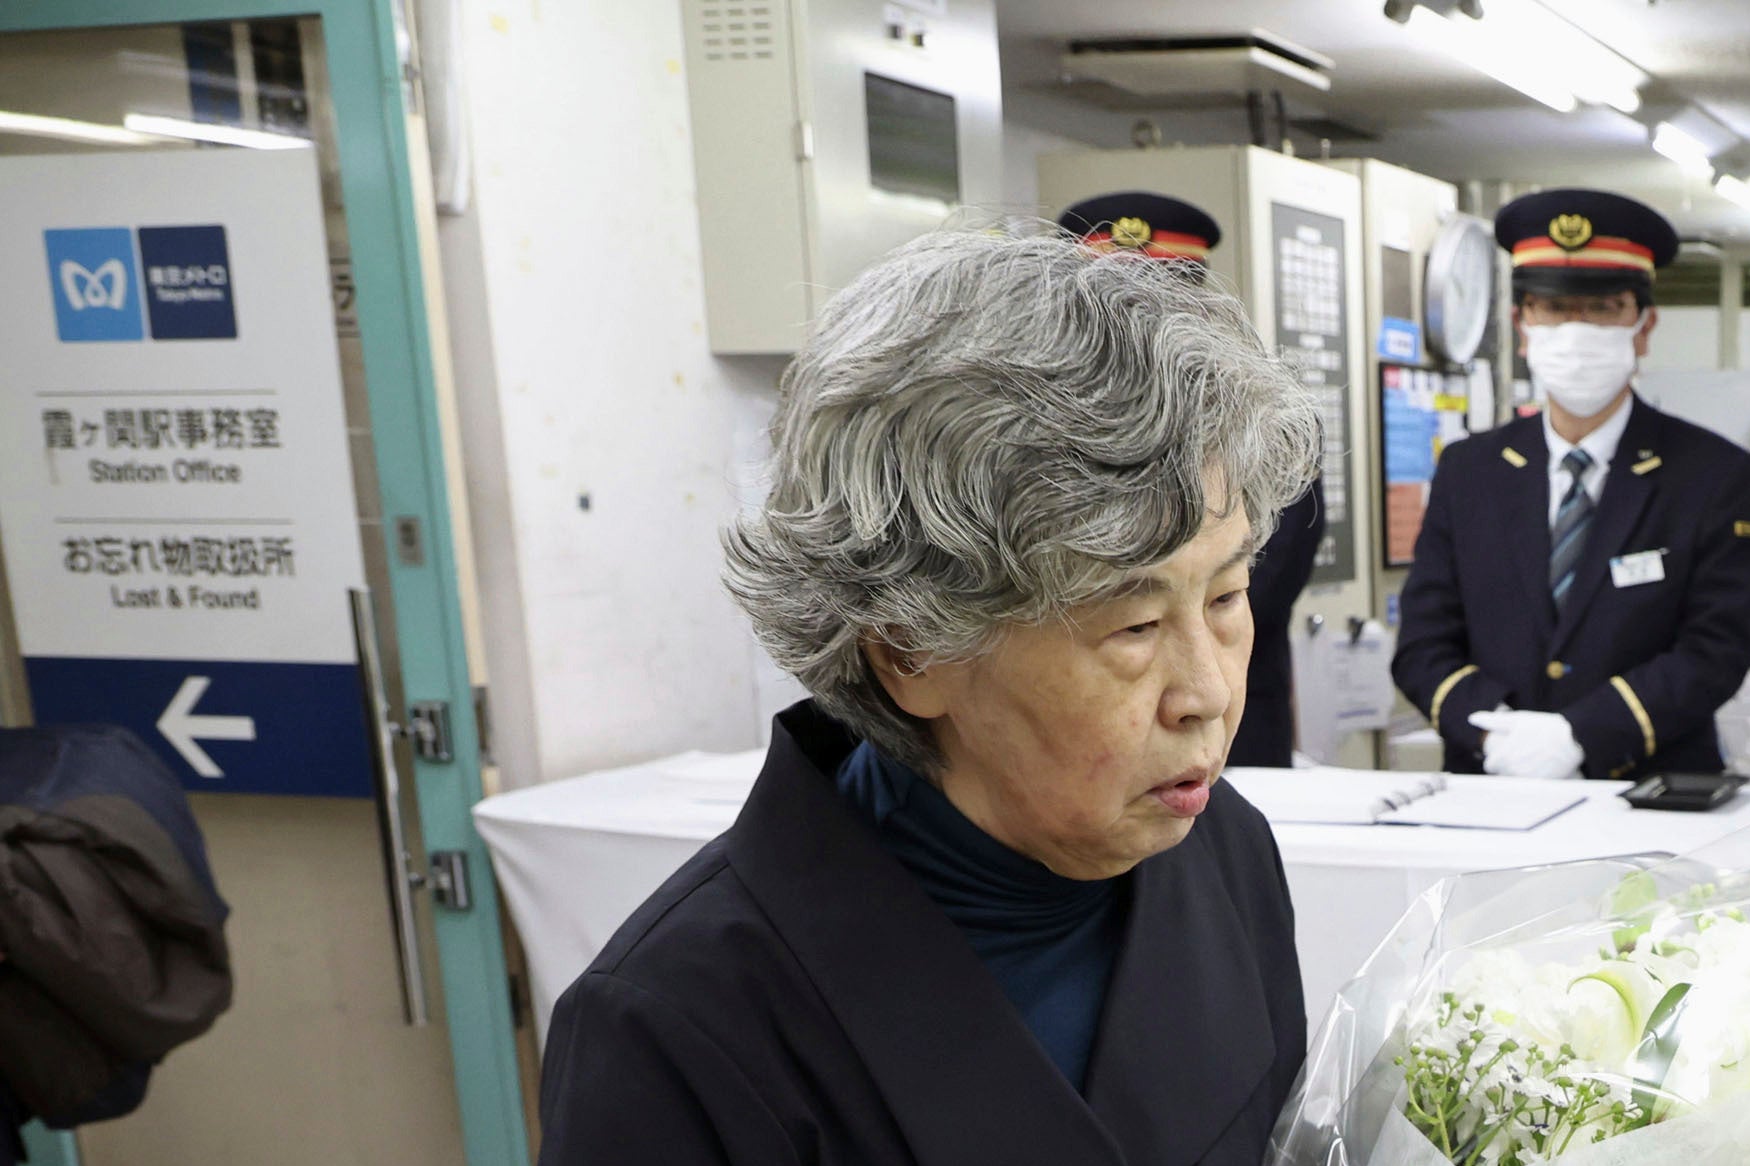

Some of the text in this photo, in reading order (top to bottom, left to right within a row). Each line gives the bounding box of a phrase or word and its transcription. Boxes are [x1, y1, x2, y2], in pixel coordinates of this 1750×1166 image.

[89, 458, 242, 483] Station Office
[62, 536, 295, 576] お忘れ物取扱所
[111, 585, 259, 609] Lost & Found
